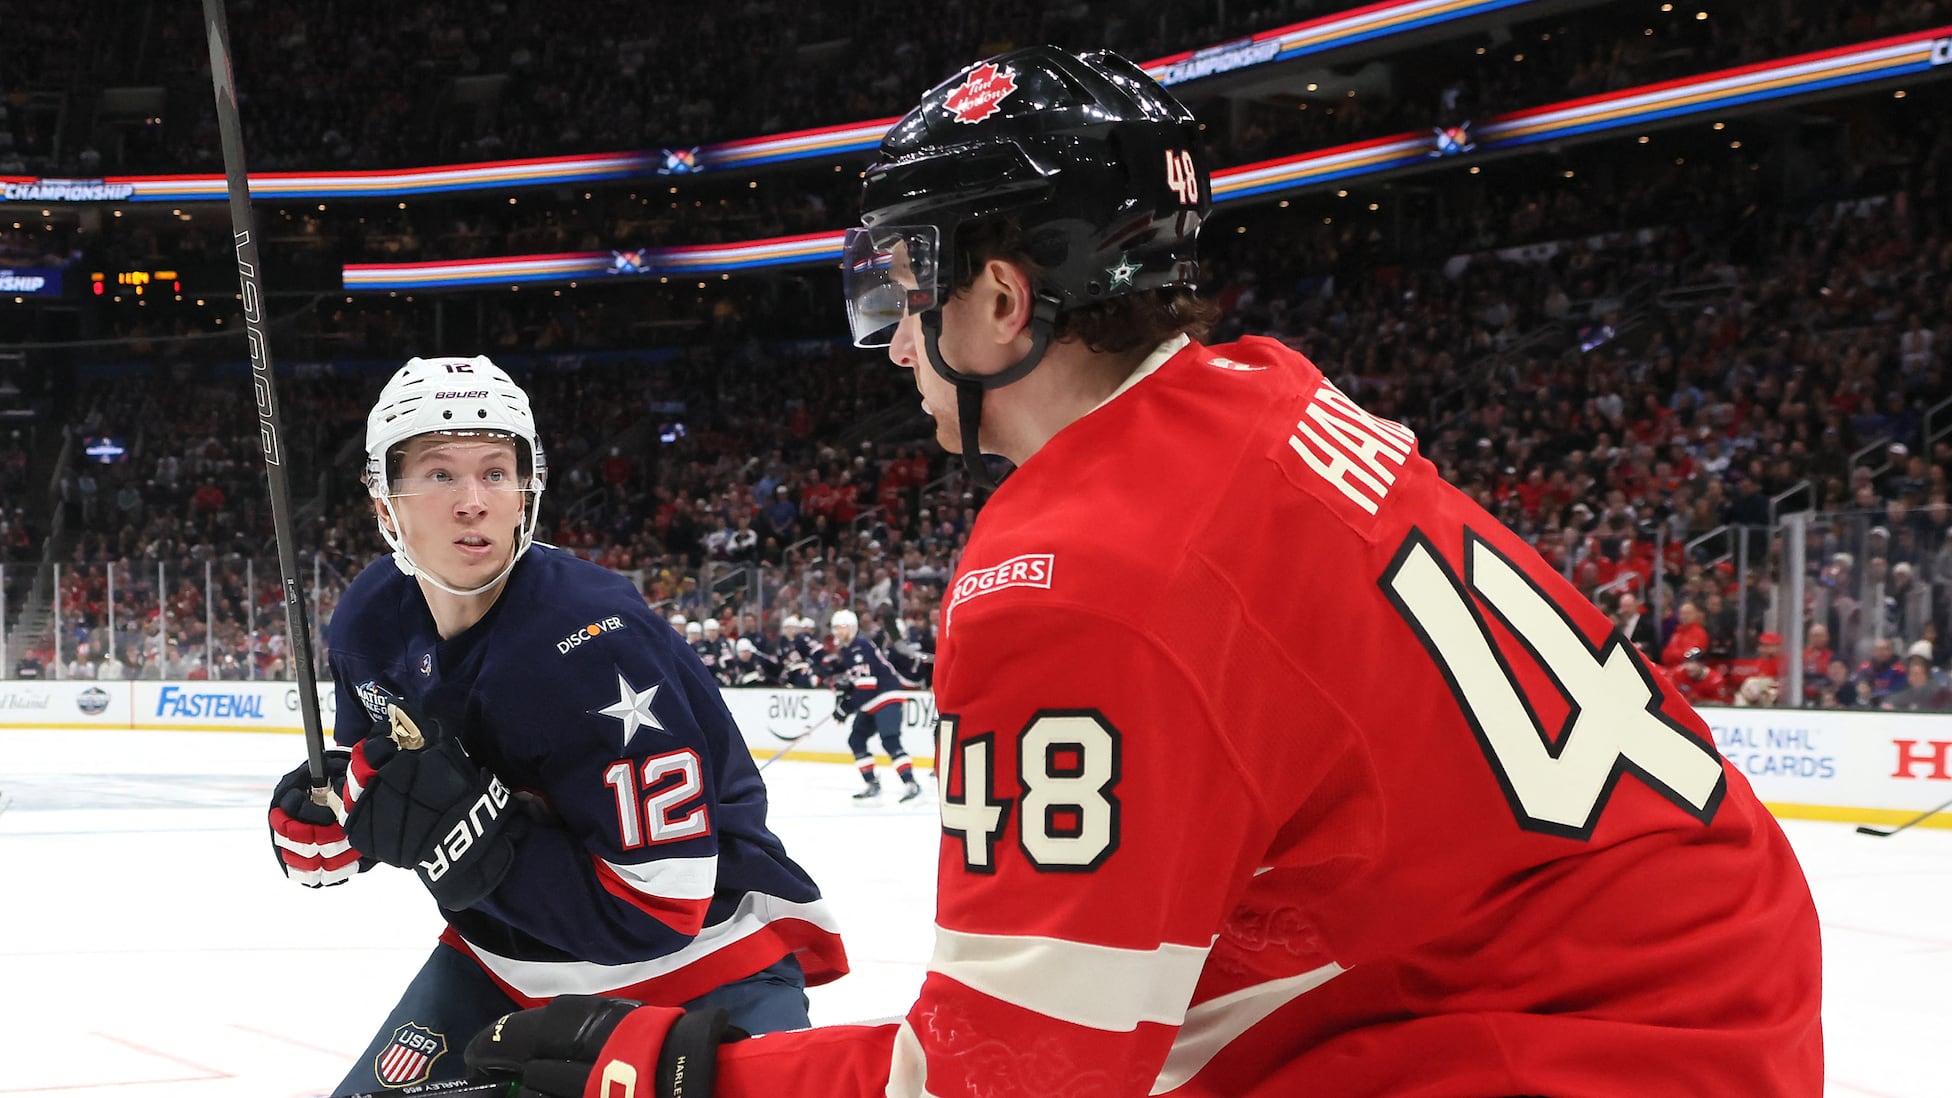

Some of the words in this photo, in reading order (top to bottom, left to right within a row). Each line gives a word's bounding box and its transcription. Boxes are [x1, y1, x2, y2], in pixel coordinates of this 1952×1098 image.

[1164, 42, 1281, 85] CHAMPIONSHIP
[1165, 148, 1199, 204] 48
[4, 183, 133, 201] CHAMPIONSHIP
[442, 362, 475, 374] 12
[556, 616, 624, 655] DISCOVER
[155, 686, 264, 718] FASTENAL
[768, 694, 811, 719] aws
[1766, 727, 1815, 750] NHL
[1747, 753, 1834, 779] CARDS
[603, 747, 712, 851] 12
[934, 707, 1122, 875] 48
[398, 1029, 438, 1054] USA
[425, 1079, 469, 1093] HARLEY
[673, 1055, 687, 1098] HARLE
